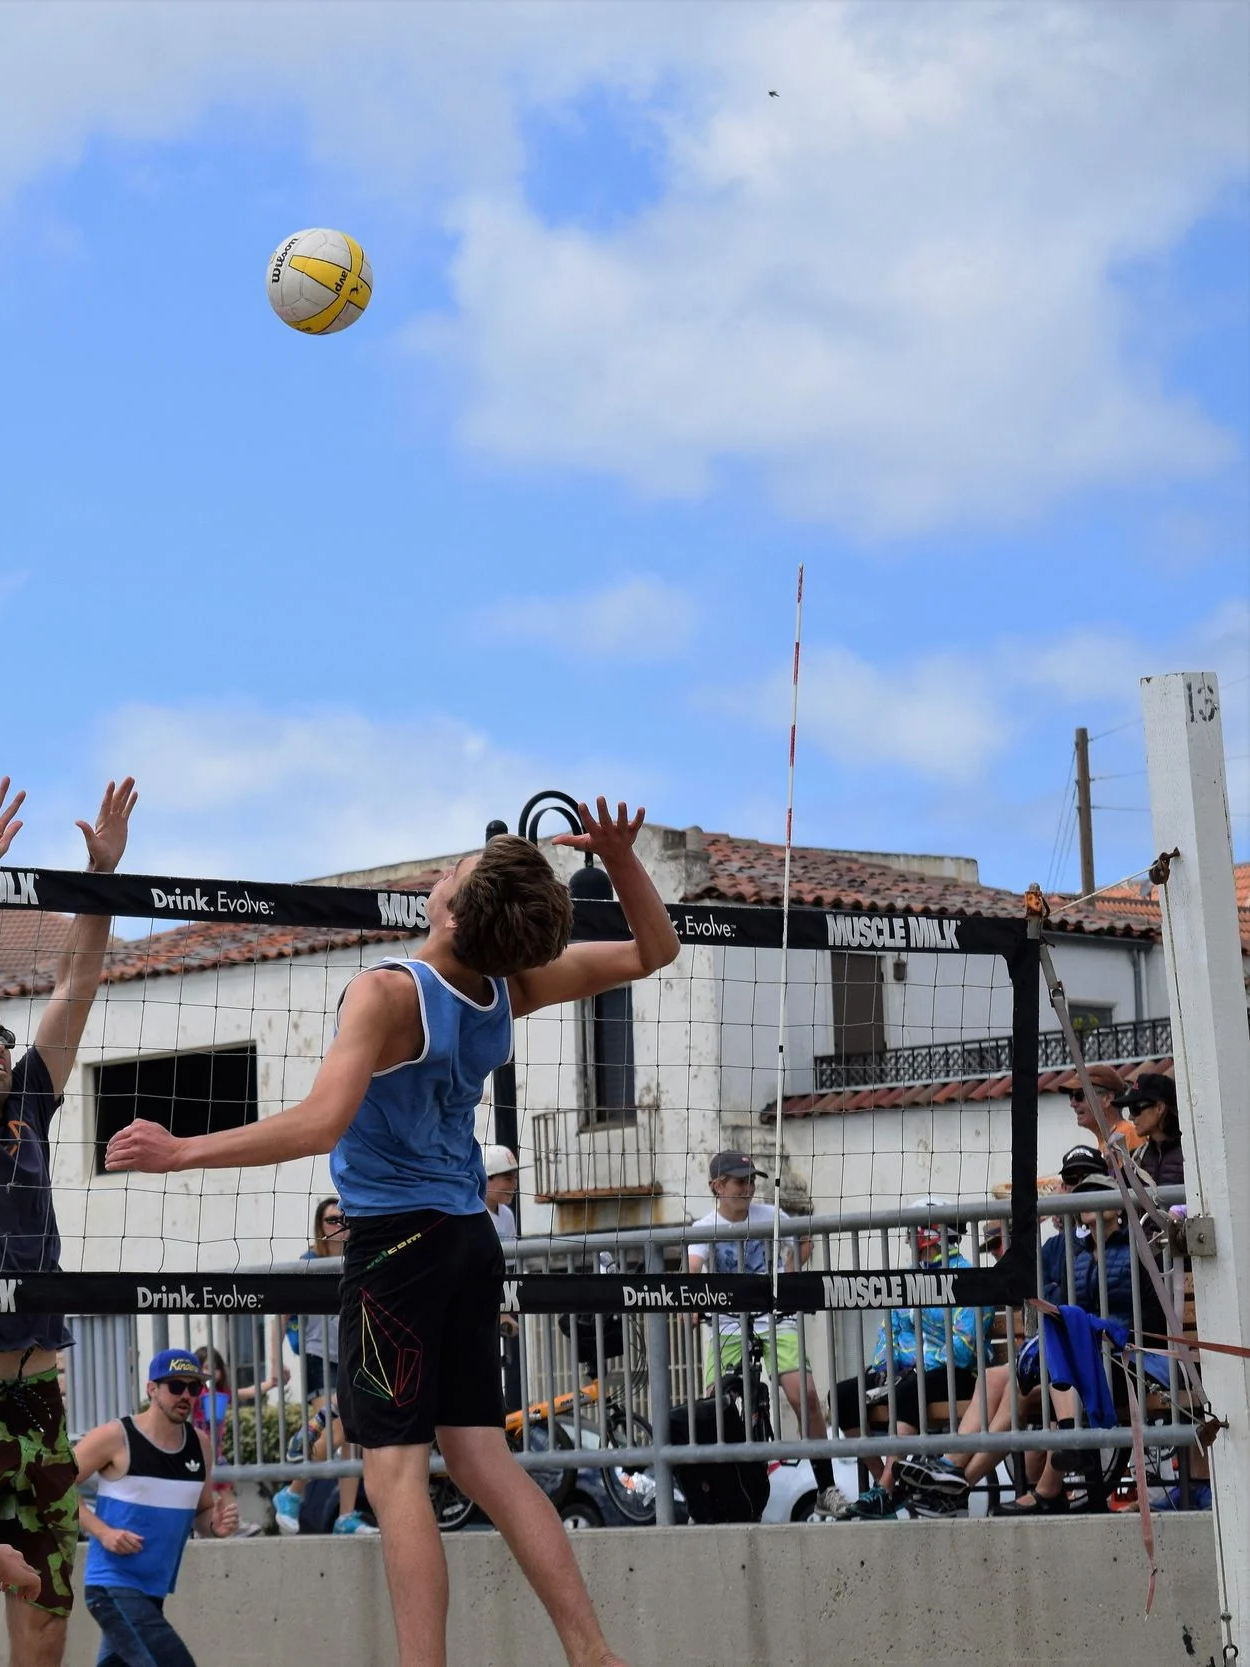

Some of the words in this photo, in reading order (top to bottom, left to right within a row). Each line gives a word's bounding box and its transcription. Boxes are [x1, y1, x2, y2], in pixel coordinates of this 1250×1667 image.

[150, 888, 215, 912] Drink.
[826, 913, 907, 948] MUSCLE
[136, 1285, 200, 1308] Drink.
[622, 1284, 679, 1307] Drink.
[822, 1275, 903, 1308] MUSCLE
